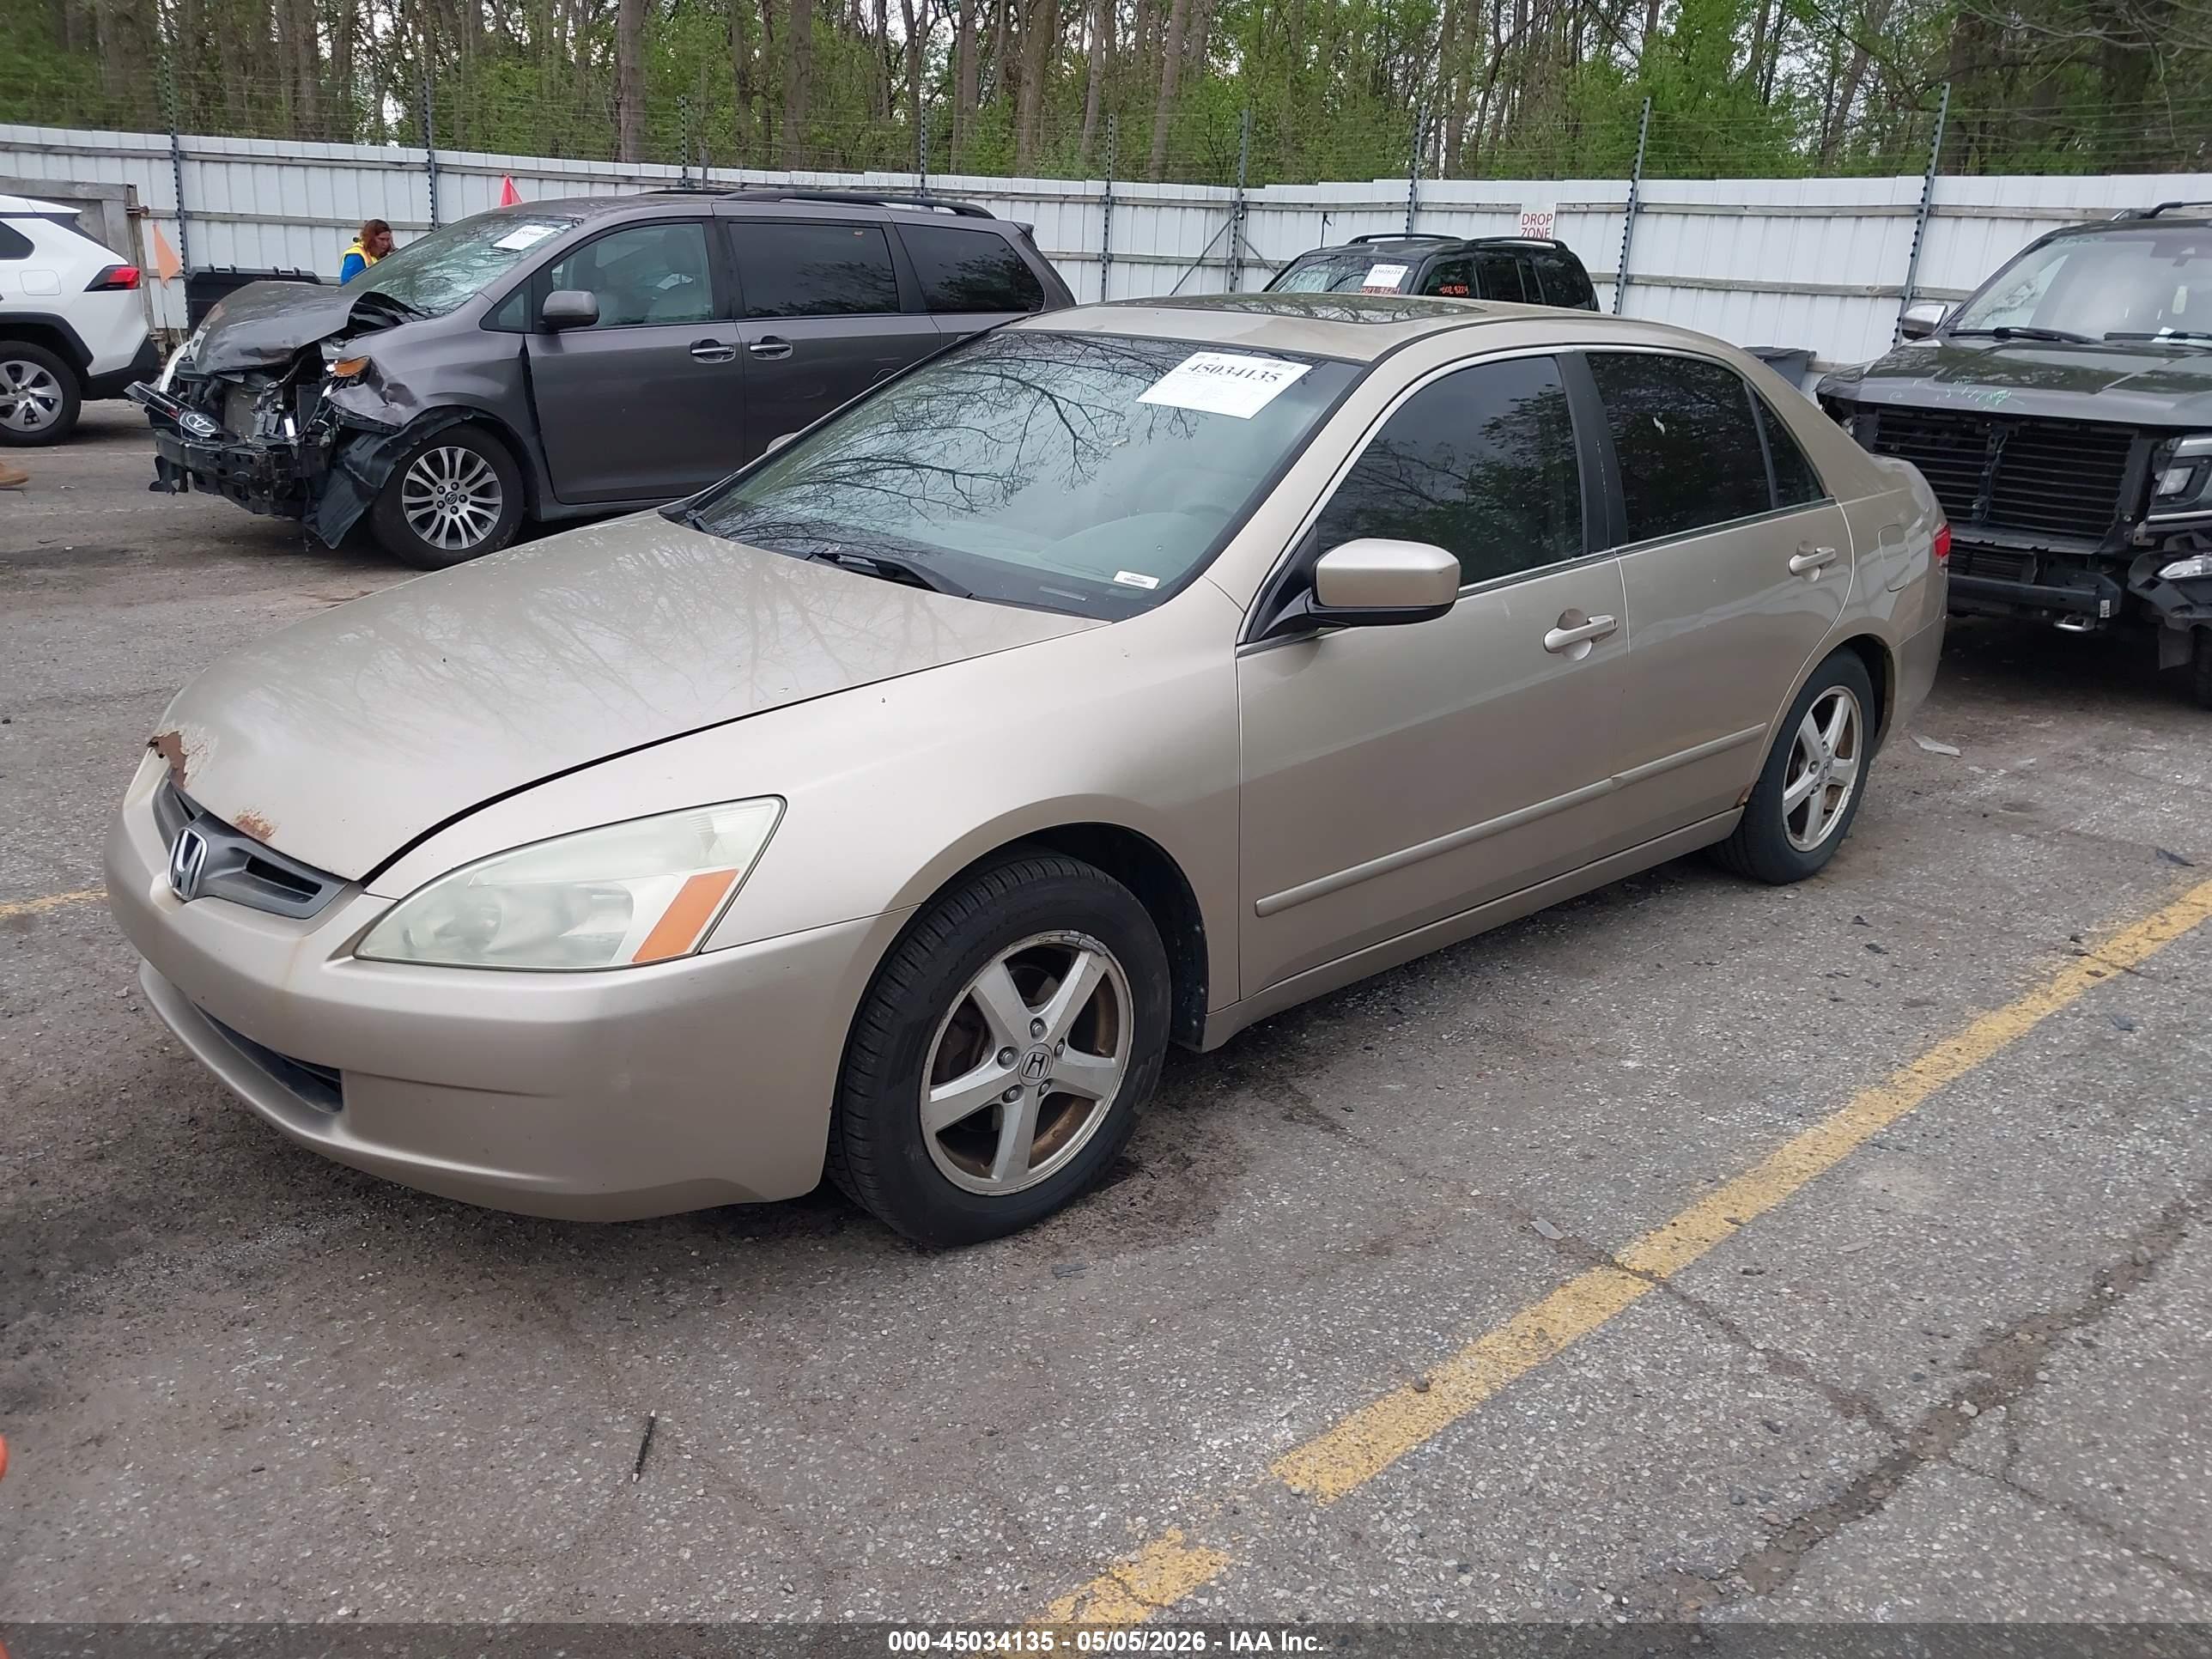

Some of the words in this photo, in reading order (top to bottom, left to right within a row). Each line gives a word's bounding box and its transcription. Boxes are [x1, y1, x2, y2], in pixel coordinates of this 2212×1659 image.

[1522, 213, 1553, 226] DROP
[1521, 227, 1551, 240] ZONE
[1188, 362, 1284, 383] 45034135
